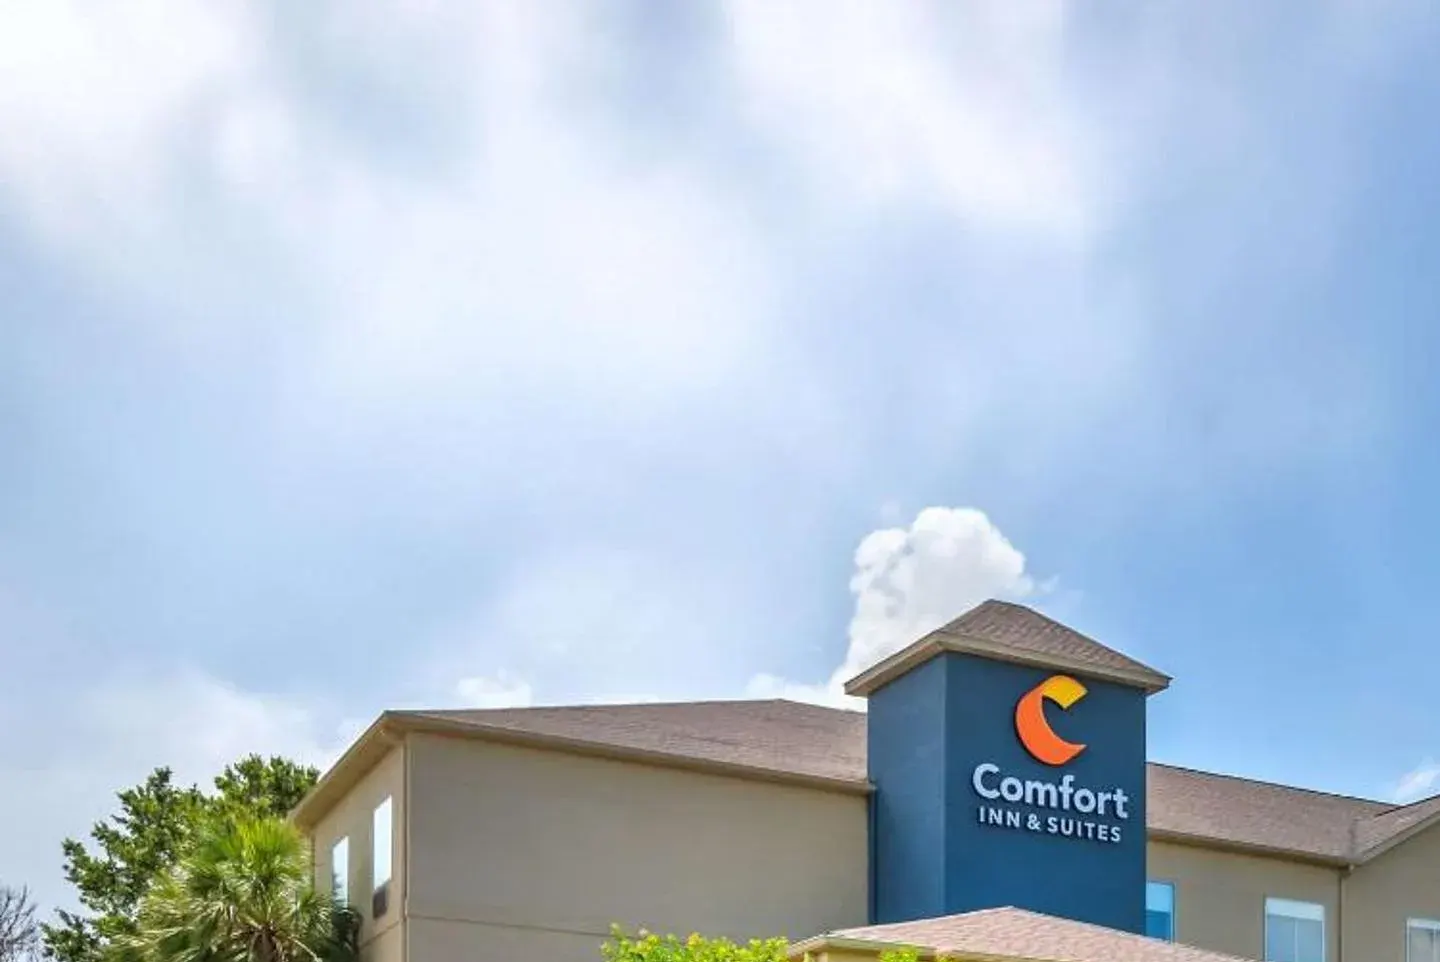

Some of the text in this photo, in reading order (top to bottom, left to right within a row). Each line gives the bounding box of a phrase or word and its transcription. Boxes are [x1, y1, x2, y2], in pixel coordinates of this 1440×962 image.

[973, 762, 1129, 819] Comfort
[979, 805, 1122, 843] INN & SUITES
